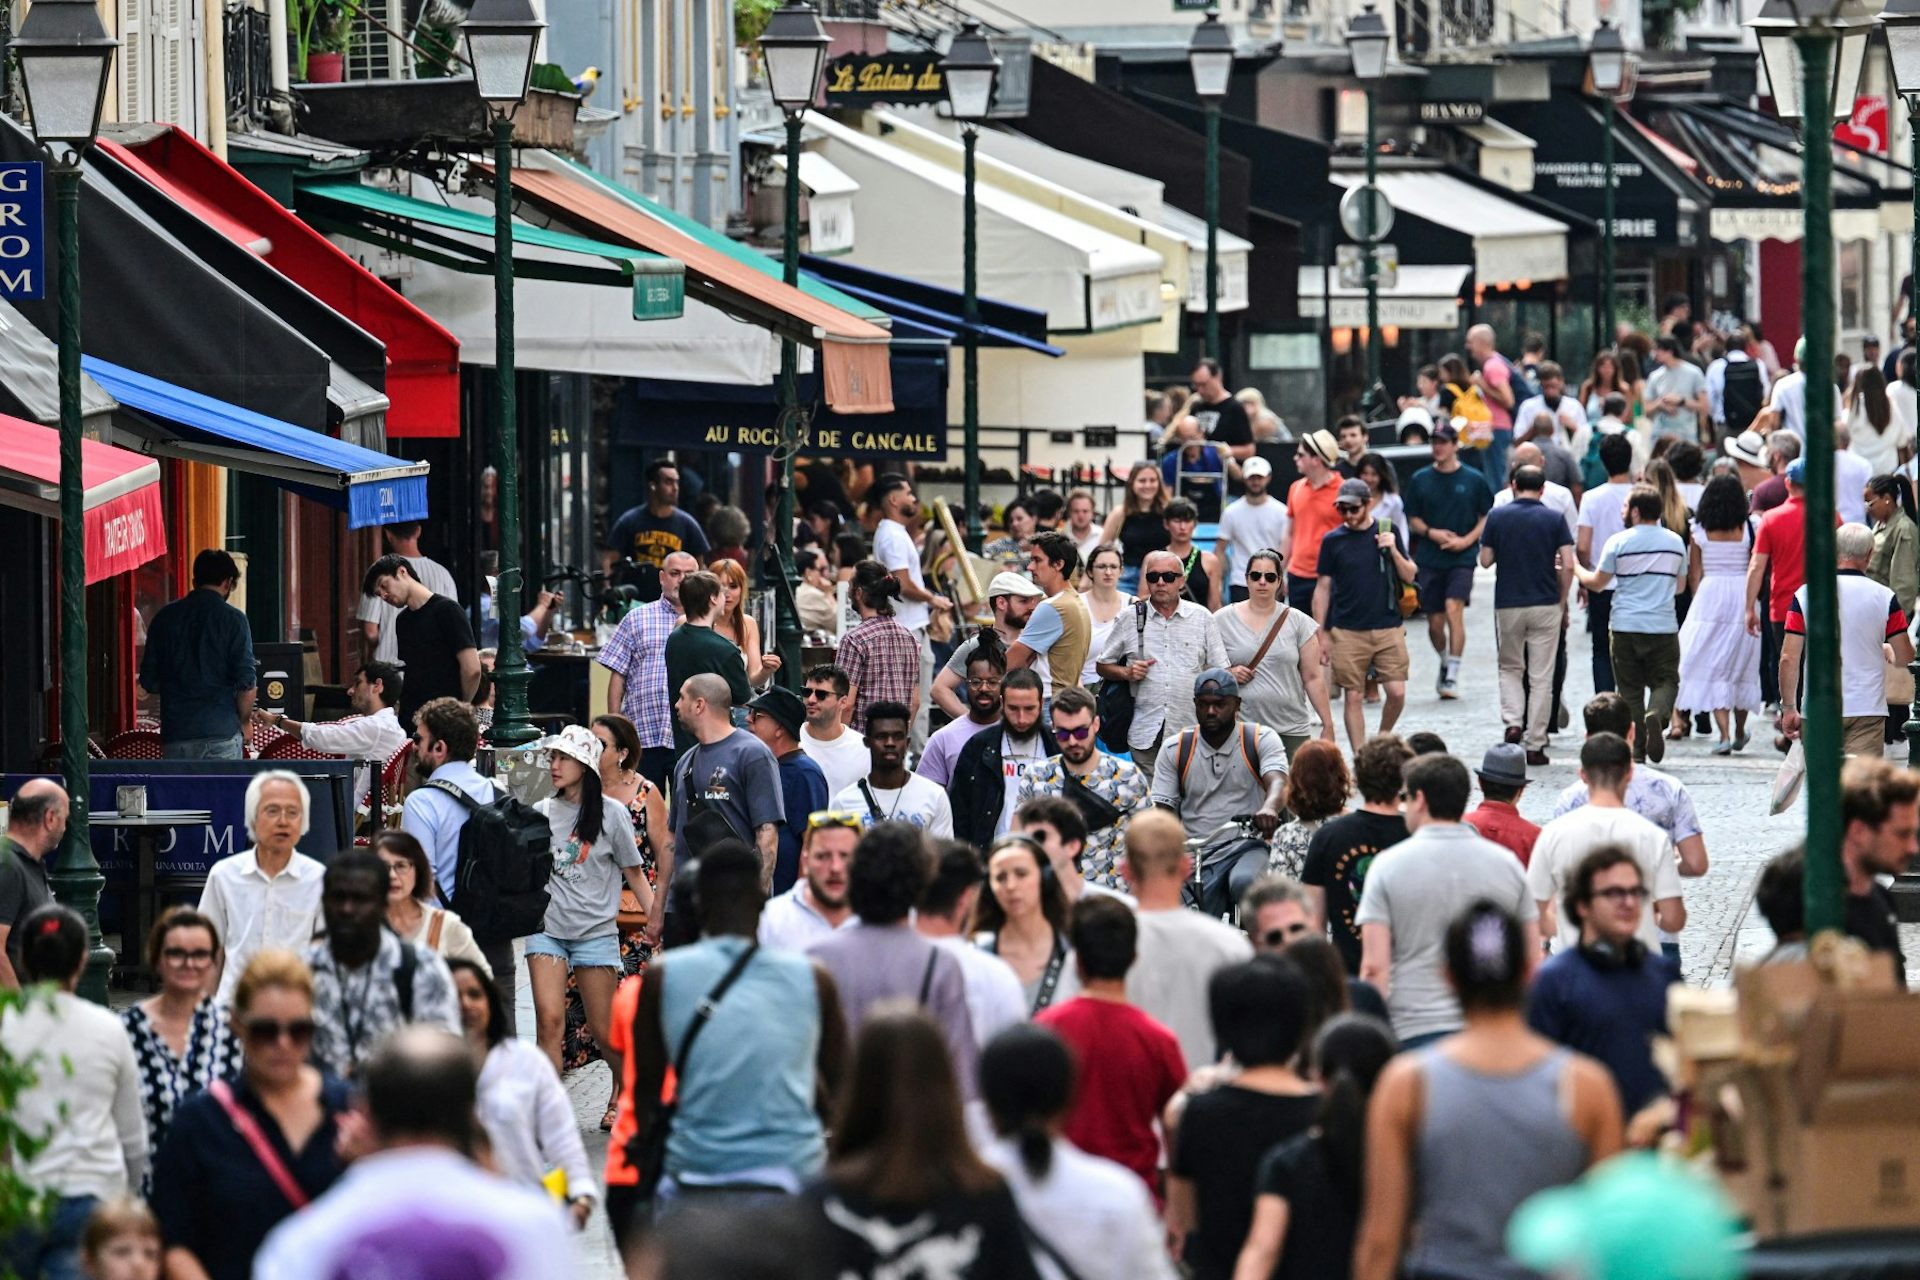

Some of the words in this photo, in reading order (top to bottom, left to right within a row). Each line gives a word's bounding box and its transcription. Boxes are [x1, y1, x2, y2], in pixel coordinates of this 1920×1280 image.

[827, 63, 855, 92] Le
[856, 62, 914, 92] Palais
[915, 63, 942, 91] du
[0, 168, 33, 293] GROM
[705, 425, 730, 444] AU
[818, 430, 842, 449] DE
[851, 431, 938, 453] CANCALE
